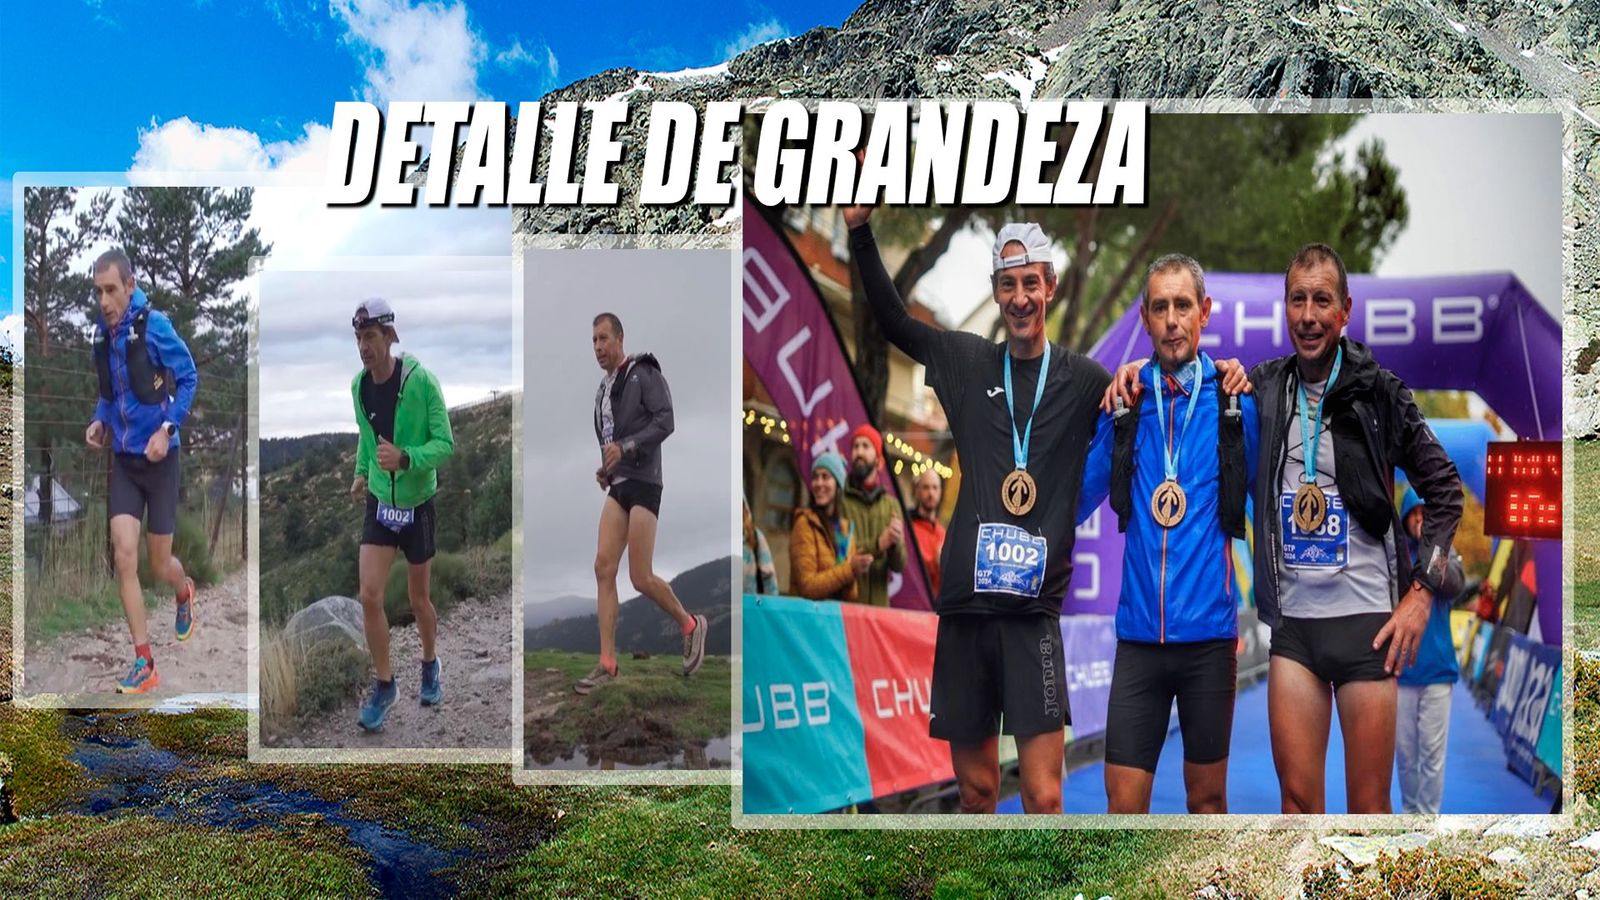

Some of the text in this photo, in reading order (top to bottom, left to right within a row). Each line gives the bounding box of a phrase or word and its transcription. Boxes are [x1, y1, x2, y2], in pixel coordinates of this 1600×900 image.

[381, 508, 410, 523] 1002
[1288, 513, 1341, 536] 18
[985, 542, 1039, 566] 1002
[1283, 544, 1296, 552] GTP
